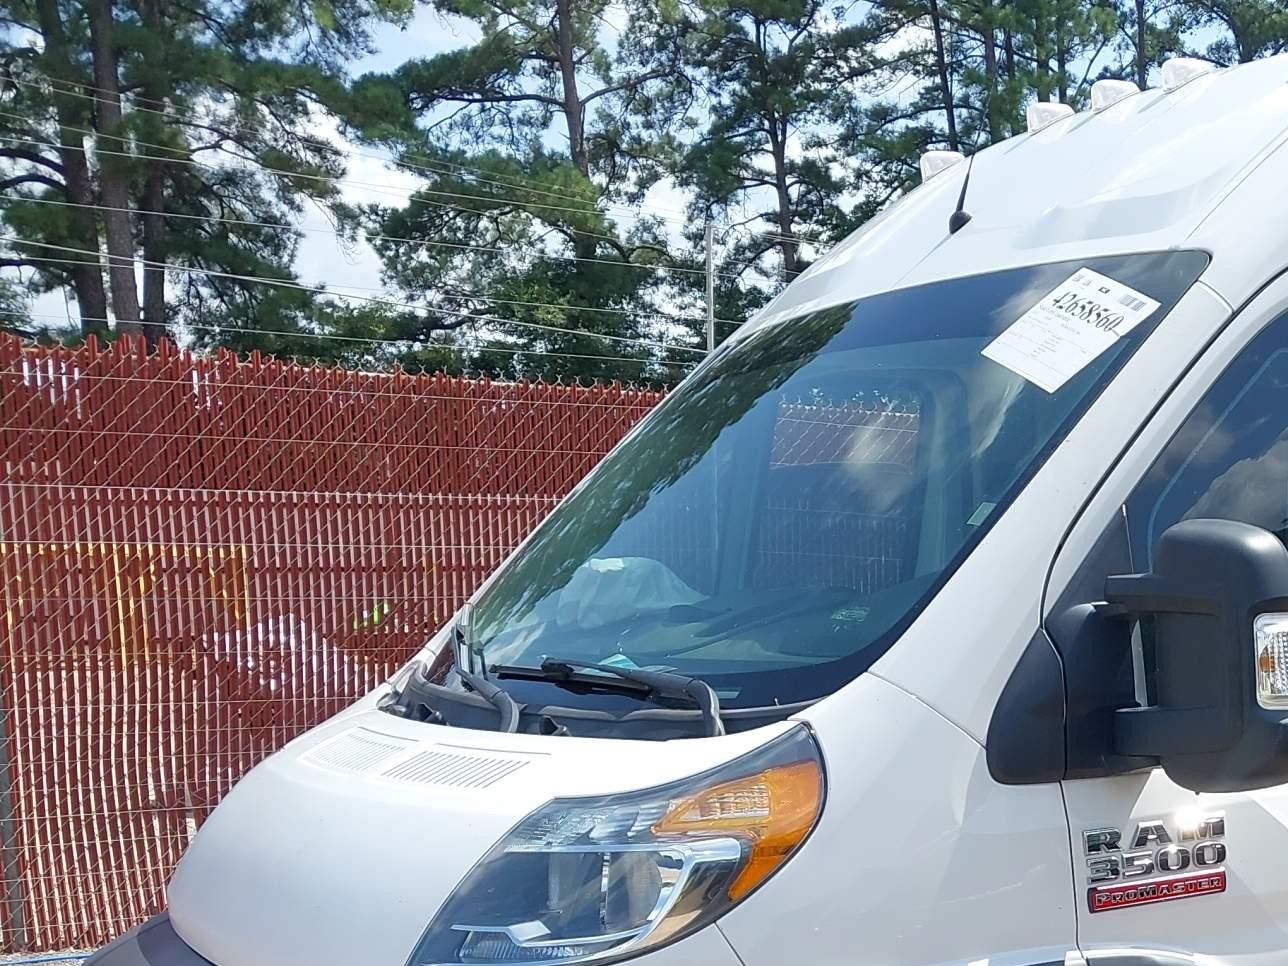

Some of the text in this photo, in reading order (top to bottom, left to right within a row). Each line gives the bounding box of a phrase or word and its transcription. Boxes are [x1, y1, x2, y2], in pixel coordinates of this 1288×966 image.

[1052, 291, 1125, 332] 42658560
[1083, 811, 1225, 855] RAM
[1087, 840, 1226, 885] 3500
